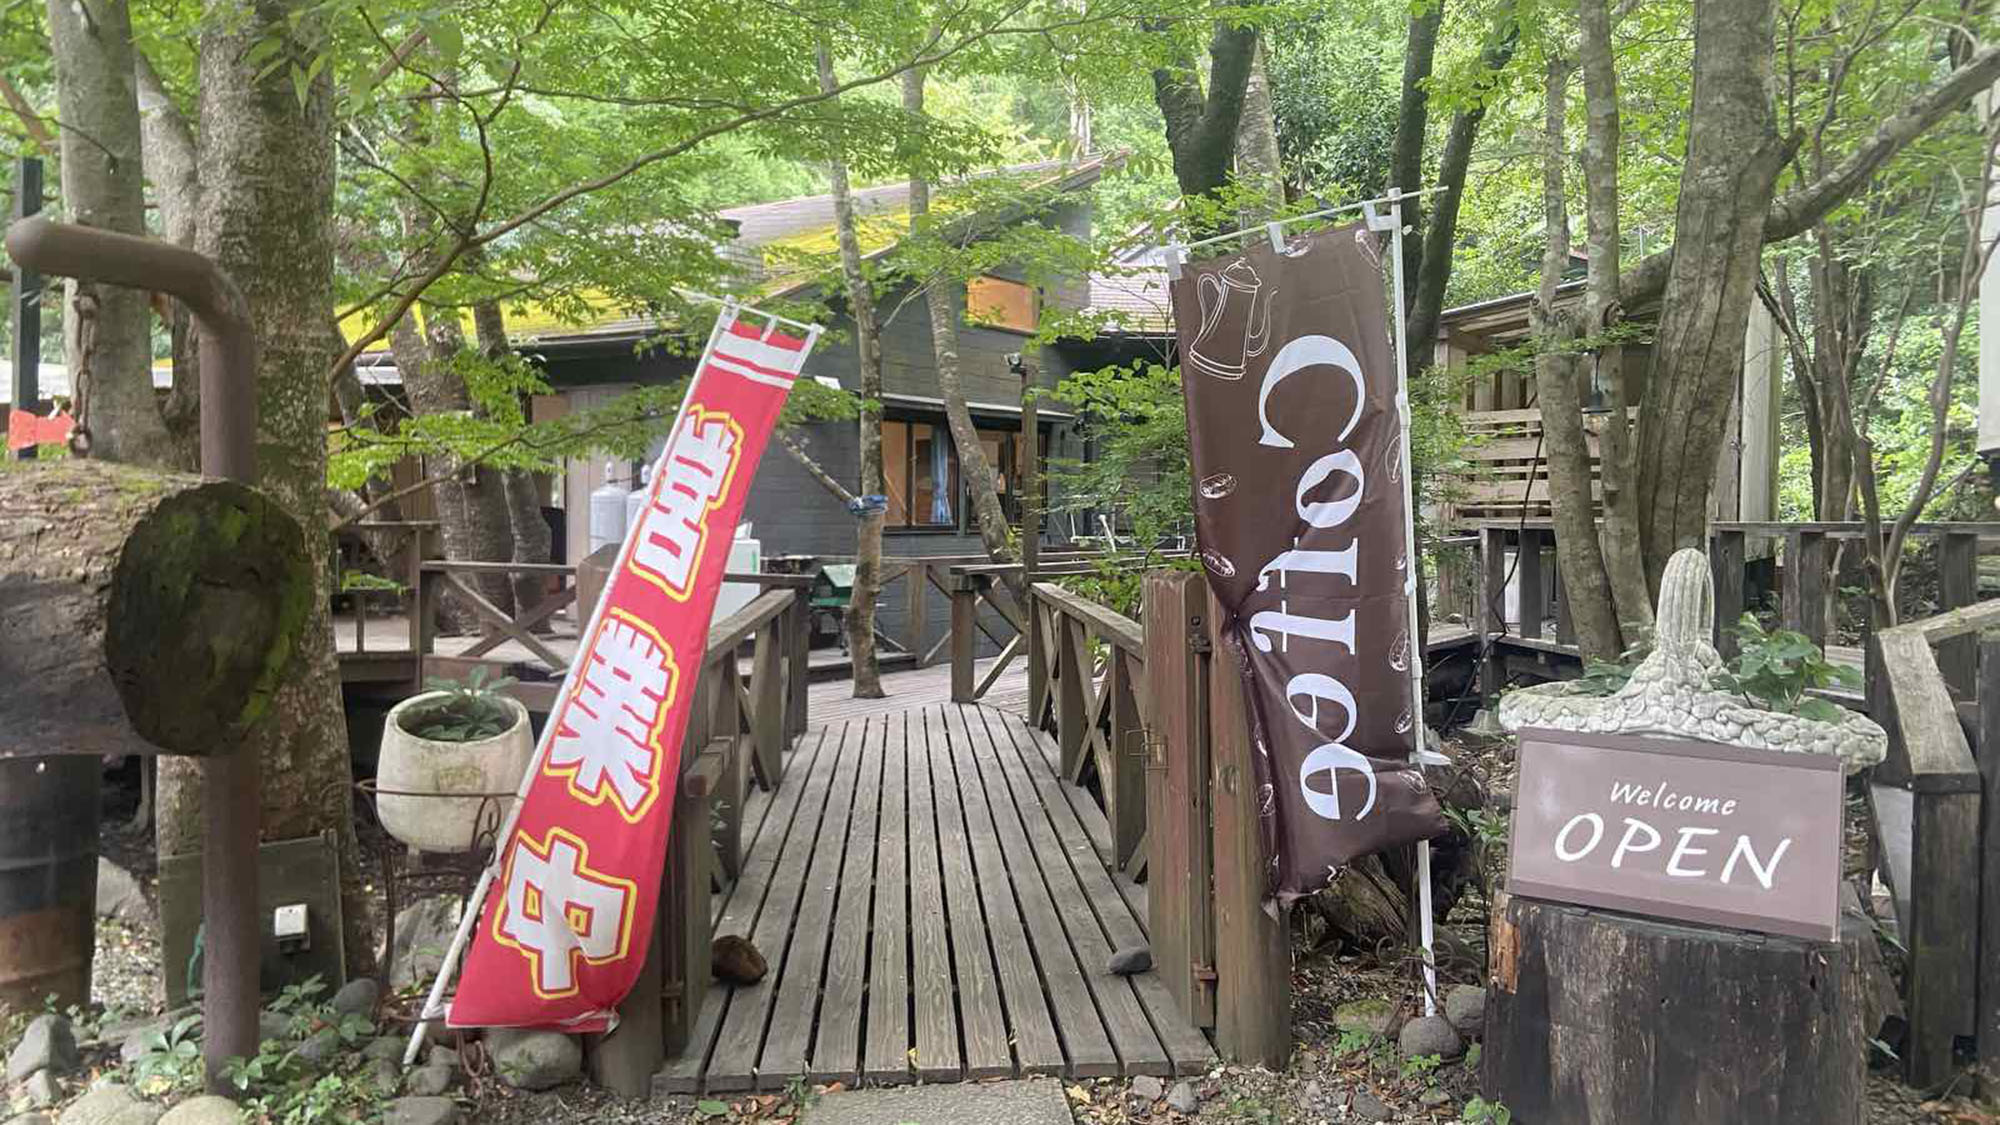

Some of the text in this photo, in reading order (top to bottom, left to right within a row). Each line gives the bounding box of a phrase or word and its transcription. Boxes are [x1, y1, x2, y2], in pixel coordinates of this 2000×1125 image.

[493, 403, 744, 1000] 営業中
[1609, 781, 1738, 816] Welcome
[1554, 812, 1792, 890] OPEN
